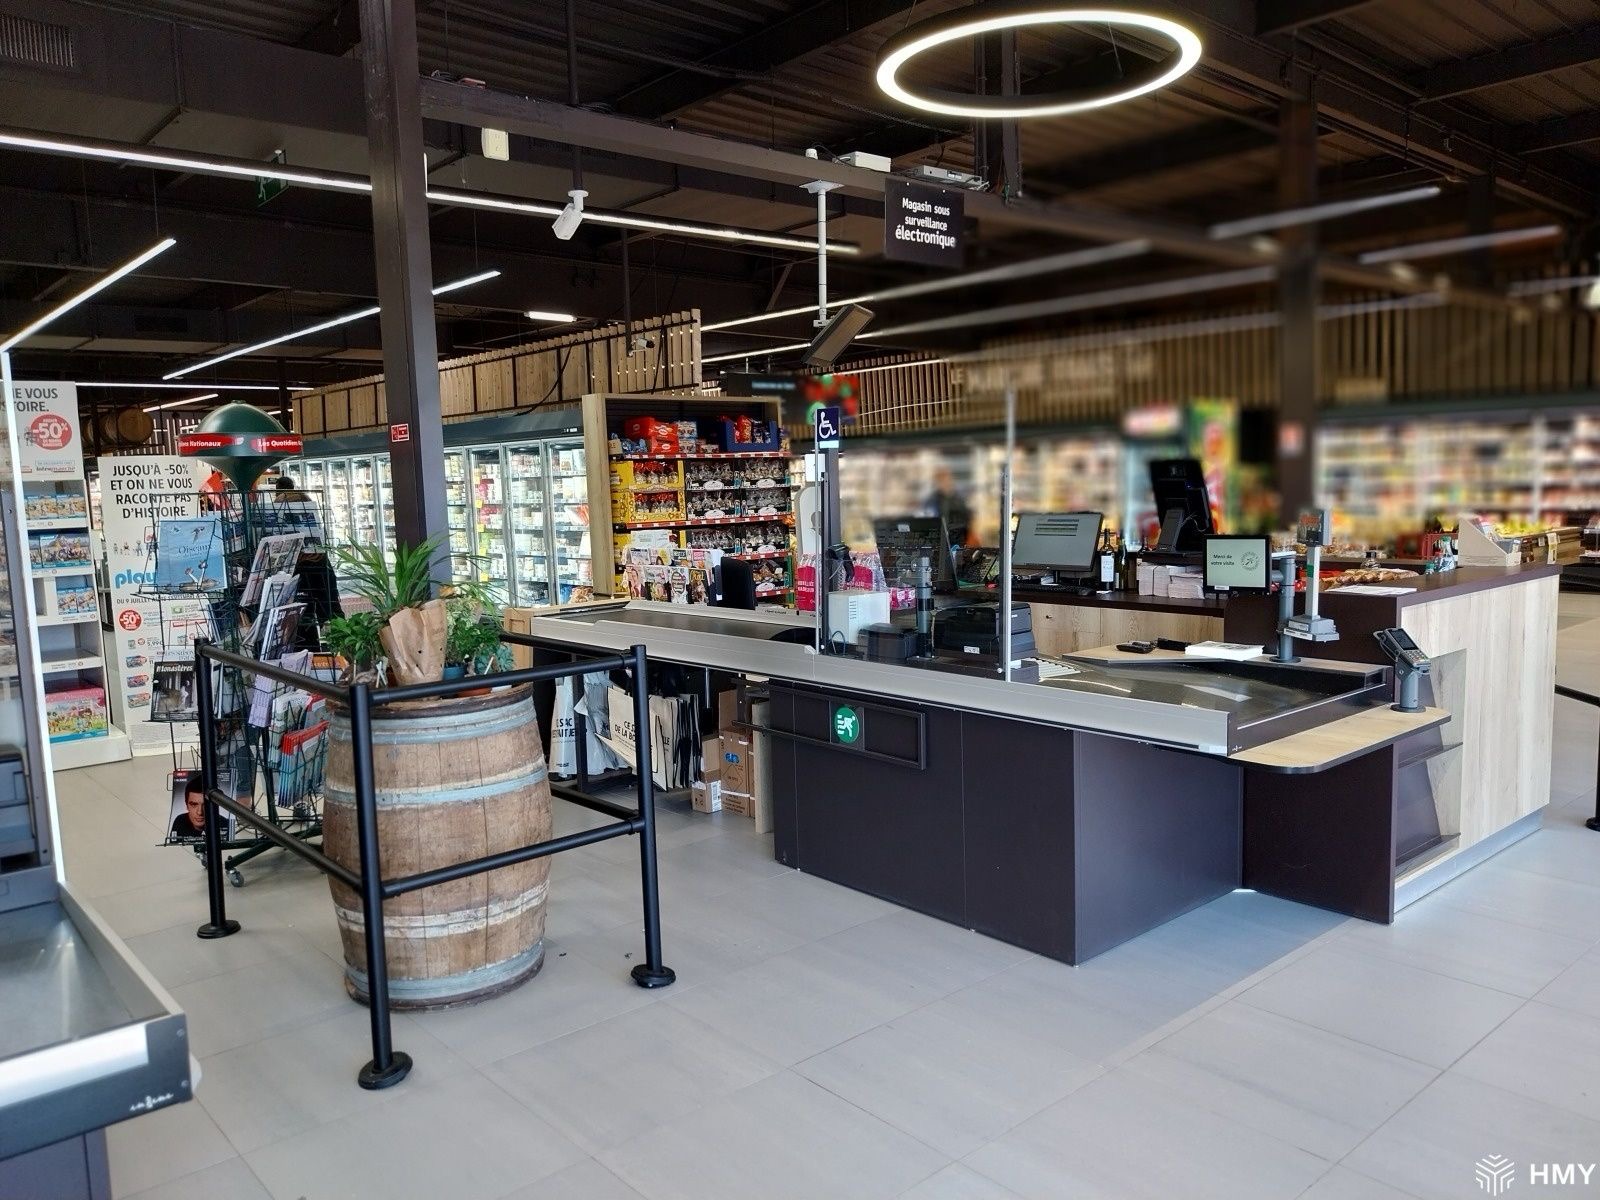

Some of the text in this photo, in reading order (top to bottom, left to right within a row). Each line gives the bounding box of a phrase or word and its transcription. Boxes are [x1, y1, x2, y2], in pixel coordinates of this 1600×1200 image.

[902, 197, 951, 216] Magasin sous
[905, 216, 948, 231] surveillance
[895, 224, 956, 249] électronique
[25, 387, 58, 399] VOUS
[190, 439, 221, 447] Nationaux
[112, 463, 189, 477] JUSQU'À -50%
[110, 478, 193, 490] ET ON NE VOUS
[116, 493, 192, 504] RACONTE PAS
[123, 506, 189, 518] D'HISTOIRE.
